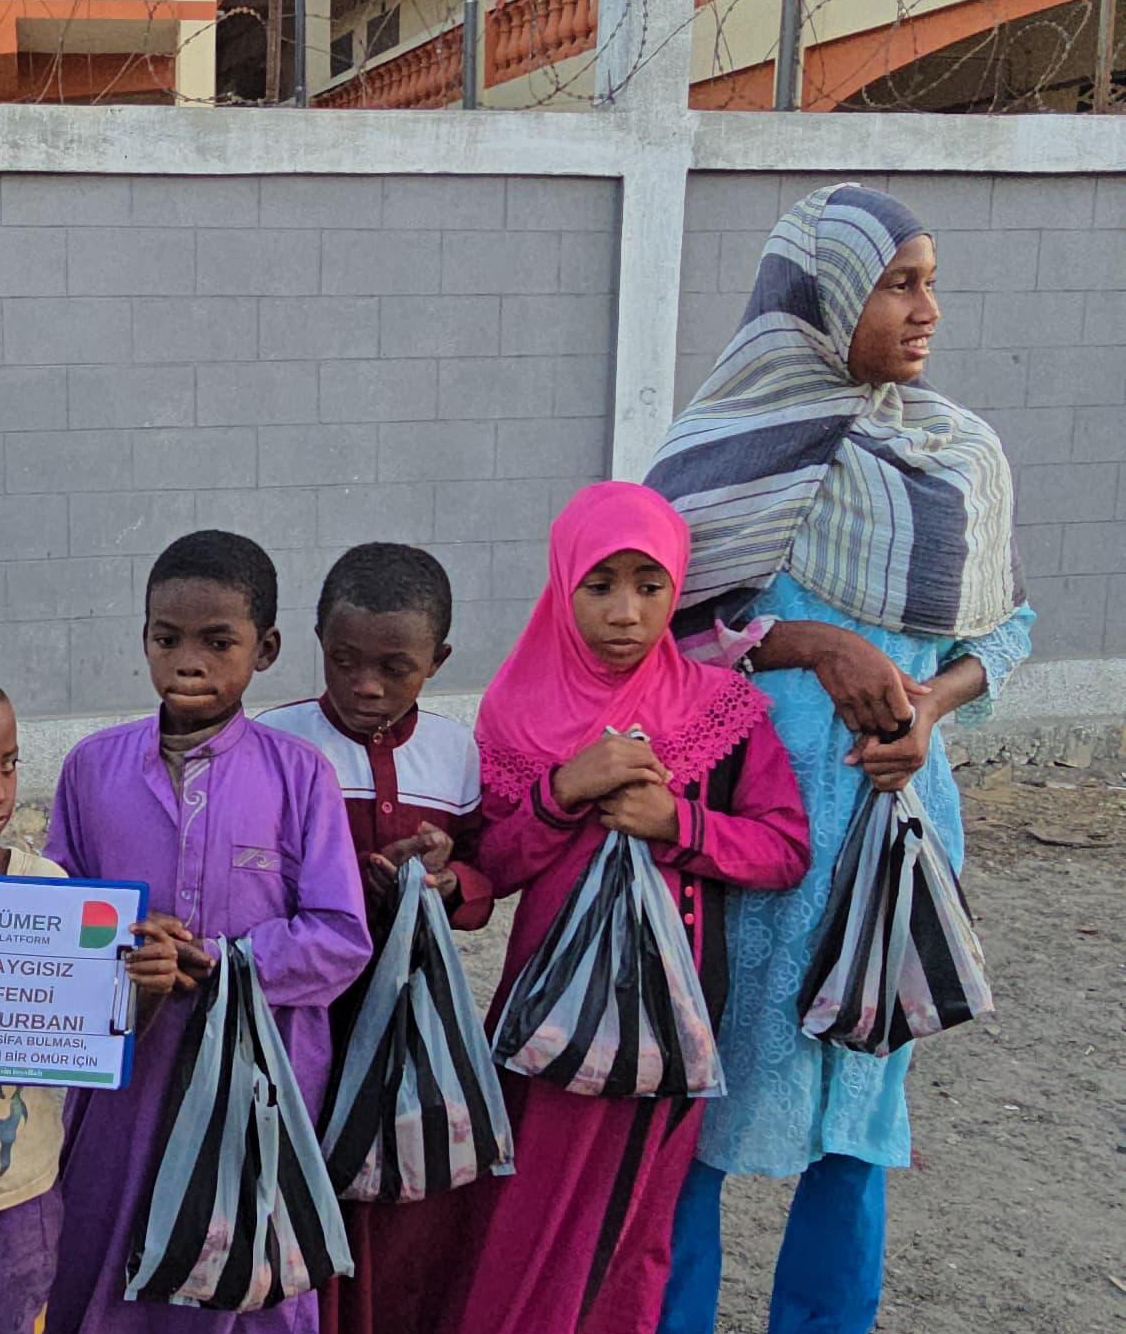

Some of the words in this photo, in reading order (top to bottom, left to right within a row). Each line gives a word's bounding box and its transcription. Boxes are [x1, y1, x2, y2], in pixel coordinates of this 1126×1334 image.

[26, 1035, 88, 1051] BULMASI,
[5, 1050, 27, 1064] BİR
[72, 1054, 99, 1069] İÇİN
